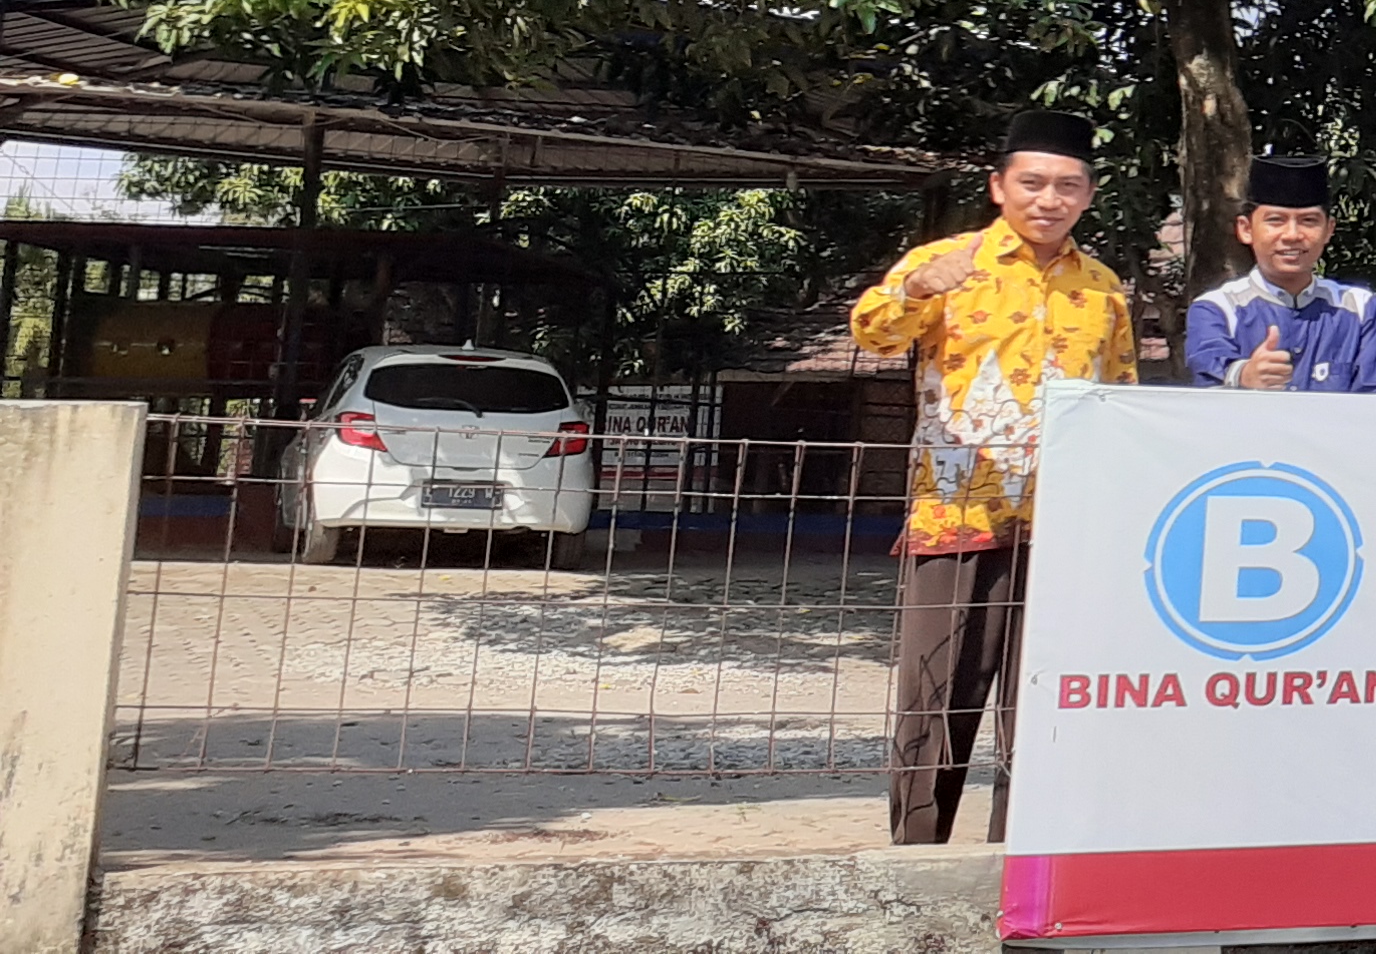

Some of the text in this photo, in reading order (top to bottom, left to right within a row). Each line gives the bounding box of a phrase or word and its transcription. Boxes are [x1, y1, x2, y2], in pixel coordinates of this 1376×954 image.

[598, 415, 632, 433] INA
[1199, 495, 1320, 622] B
[1057, 673, 1188, 709] BINA
